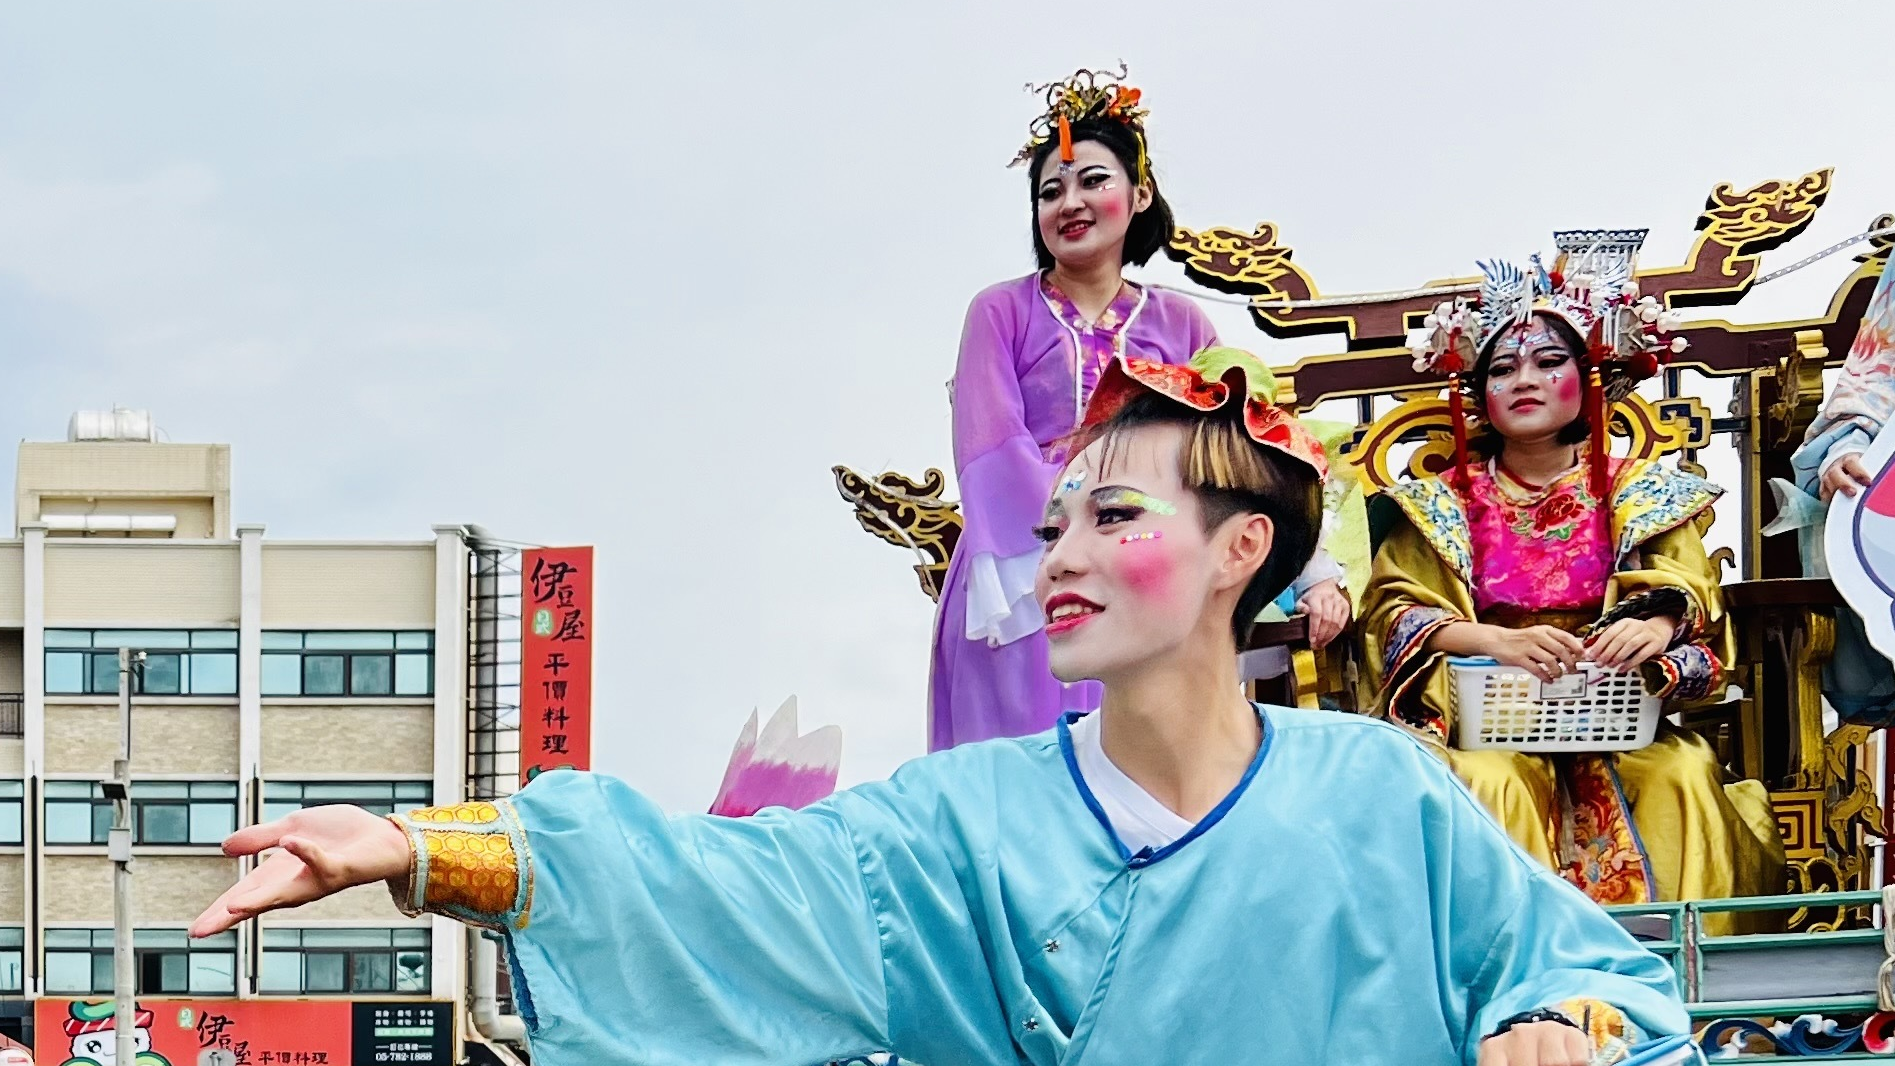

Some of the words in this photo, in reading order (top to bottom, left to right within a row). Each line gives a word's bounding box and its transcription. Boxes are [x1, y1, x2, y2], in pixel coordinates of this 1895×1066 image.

[530, 557, 585, 642] 伊豆屋
[542, 653, 570, 755] 平價料理
[197, 1010, 252, 1066] 伊豆屋
